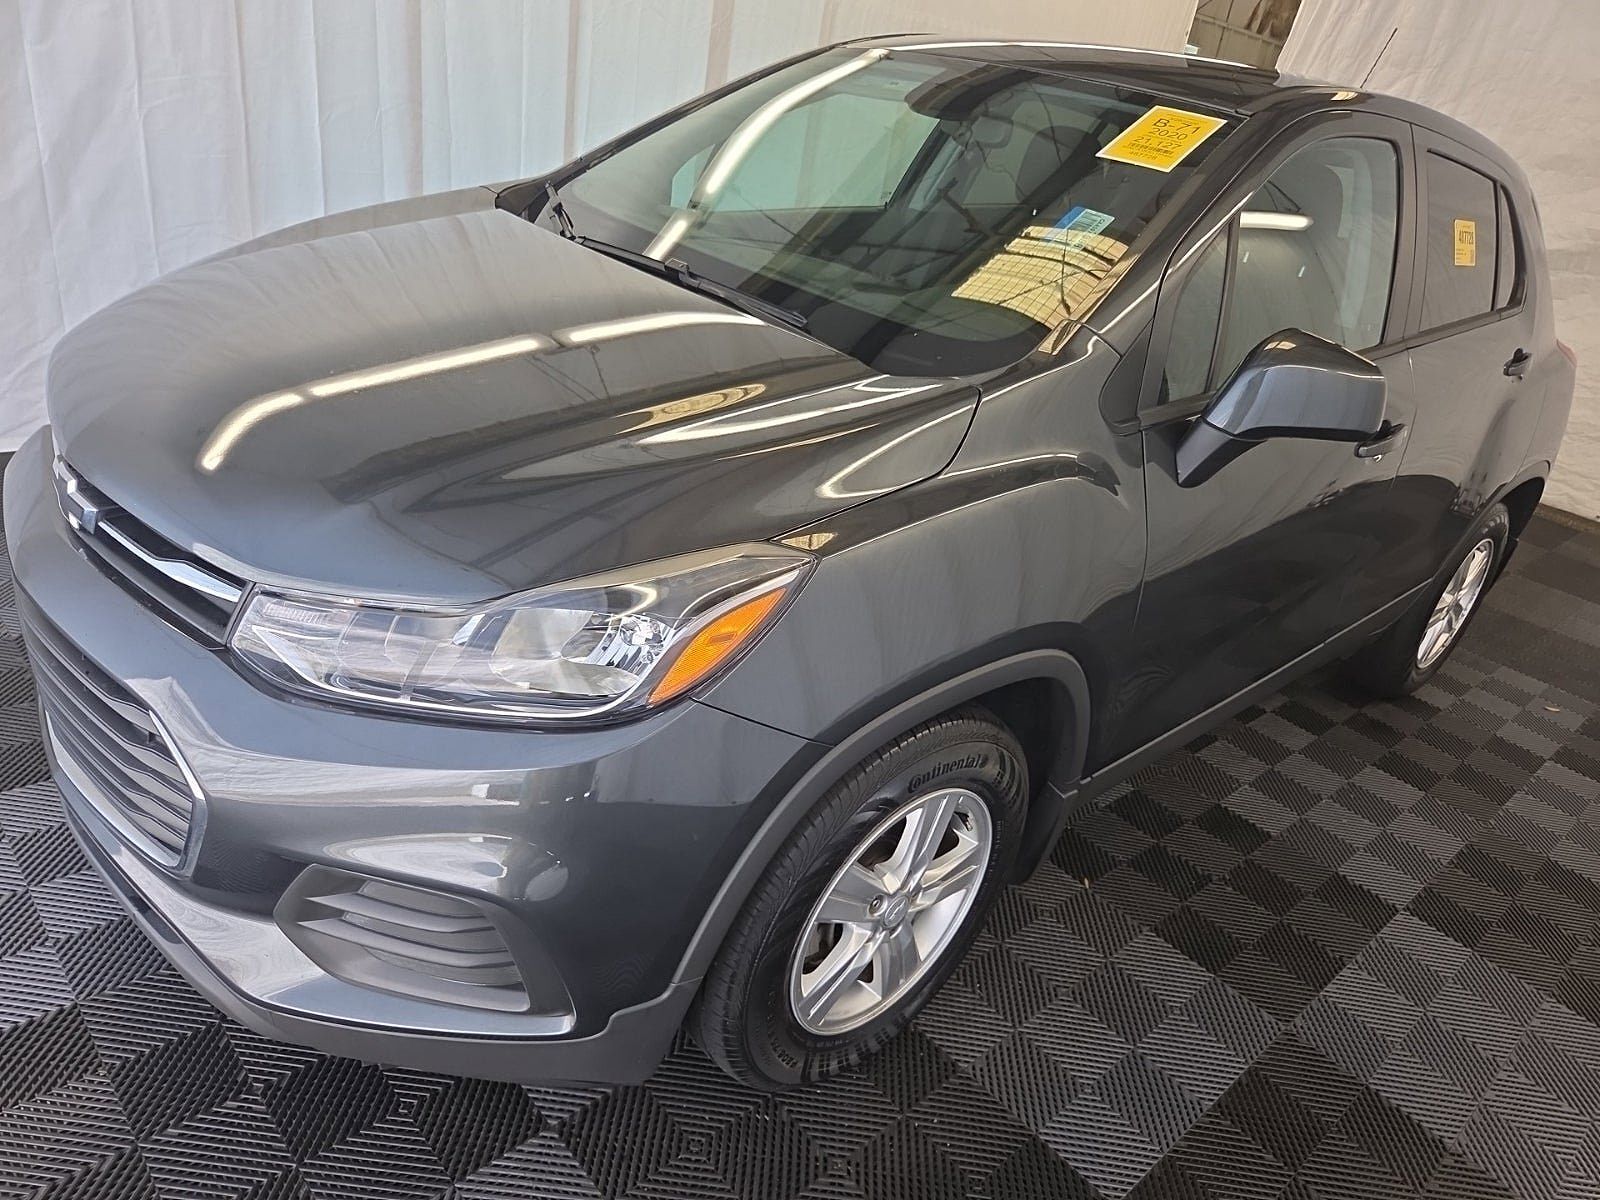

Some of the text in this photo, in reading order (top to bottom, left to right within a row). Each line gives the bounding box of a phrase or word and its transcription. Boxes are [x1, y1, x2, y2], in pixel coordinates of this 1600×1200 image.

[1148, 127, 1188, 141] 2020
[1152, 118, 1202, 134] B-71
[907, 754, 981, 794] Continental
